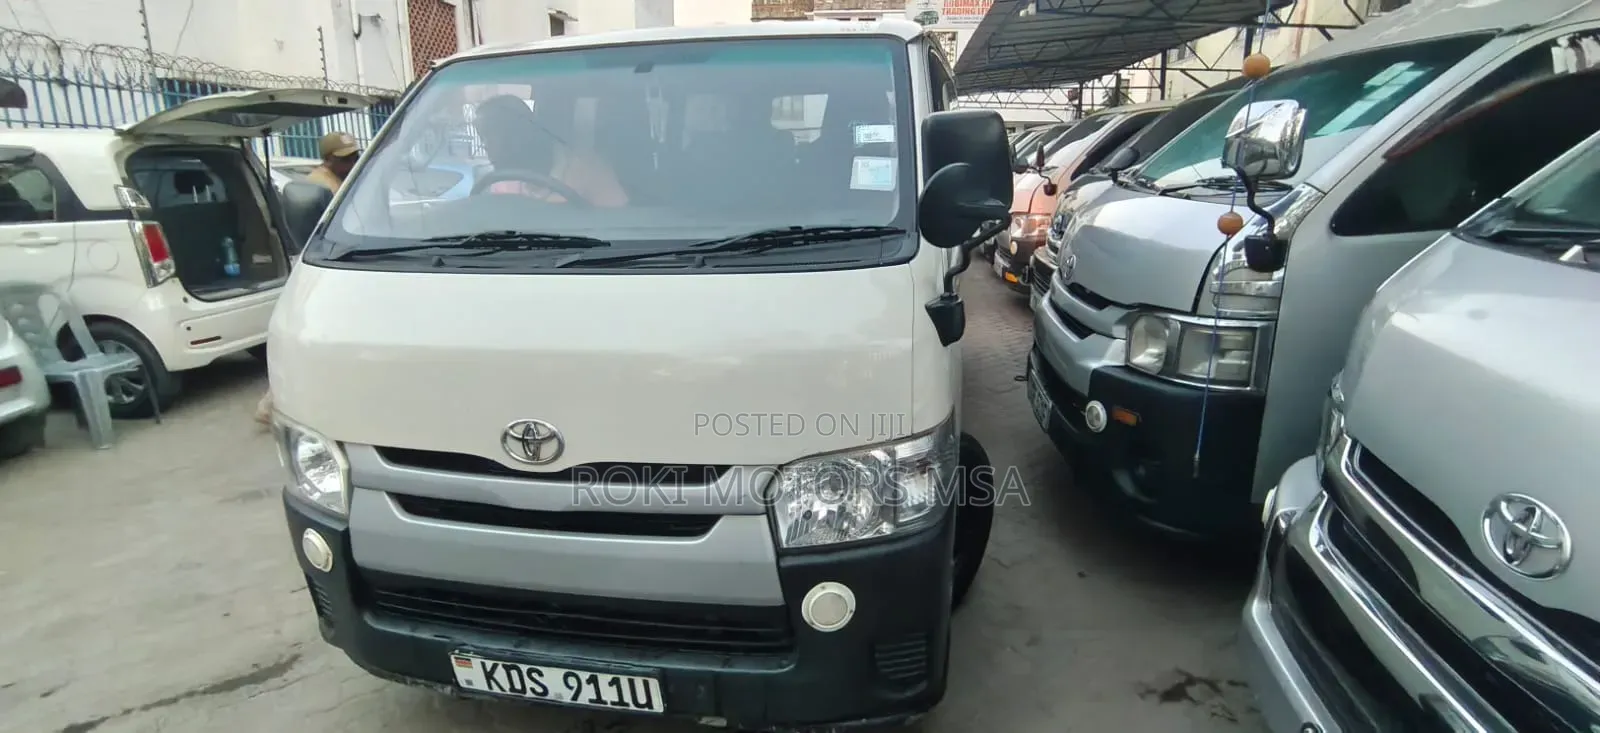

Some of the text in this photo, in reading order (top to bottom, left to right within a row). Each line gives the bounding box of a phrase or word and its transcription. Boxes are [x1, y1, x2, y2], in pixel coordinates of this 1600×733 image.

[942, 7, 976, 15] TRADING
[480, 660, 655, 711] KDS 911U
